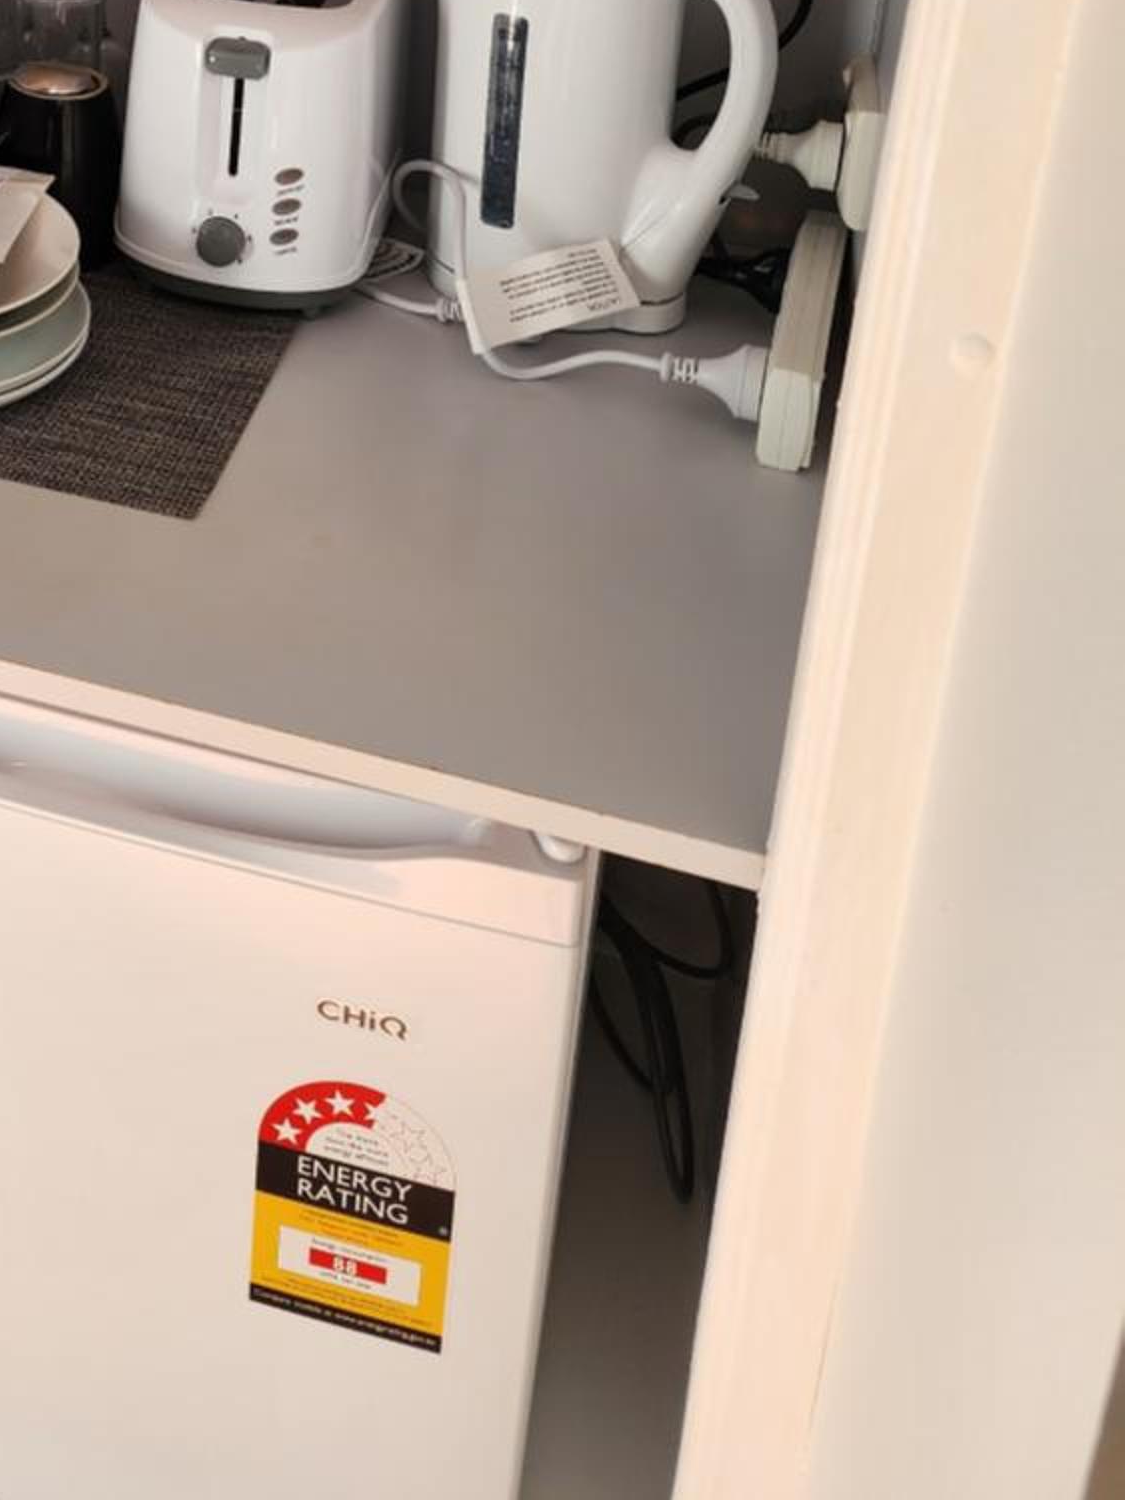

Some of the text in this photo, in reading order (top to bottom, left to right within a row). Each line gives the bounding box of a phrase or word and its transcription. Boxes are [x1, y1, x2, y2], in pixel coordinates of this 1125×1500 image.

[316, 999, 408, 1041] CHiQ
[296, 1155, 413, 1202] ENERGY
[296, 1177, 409, 1225] RATING
